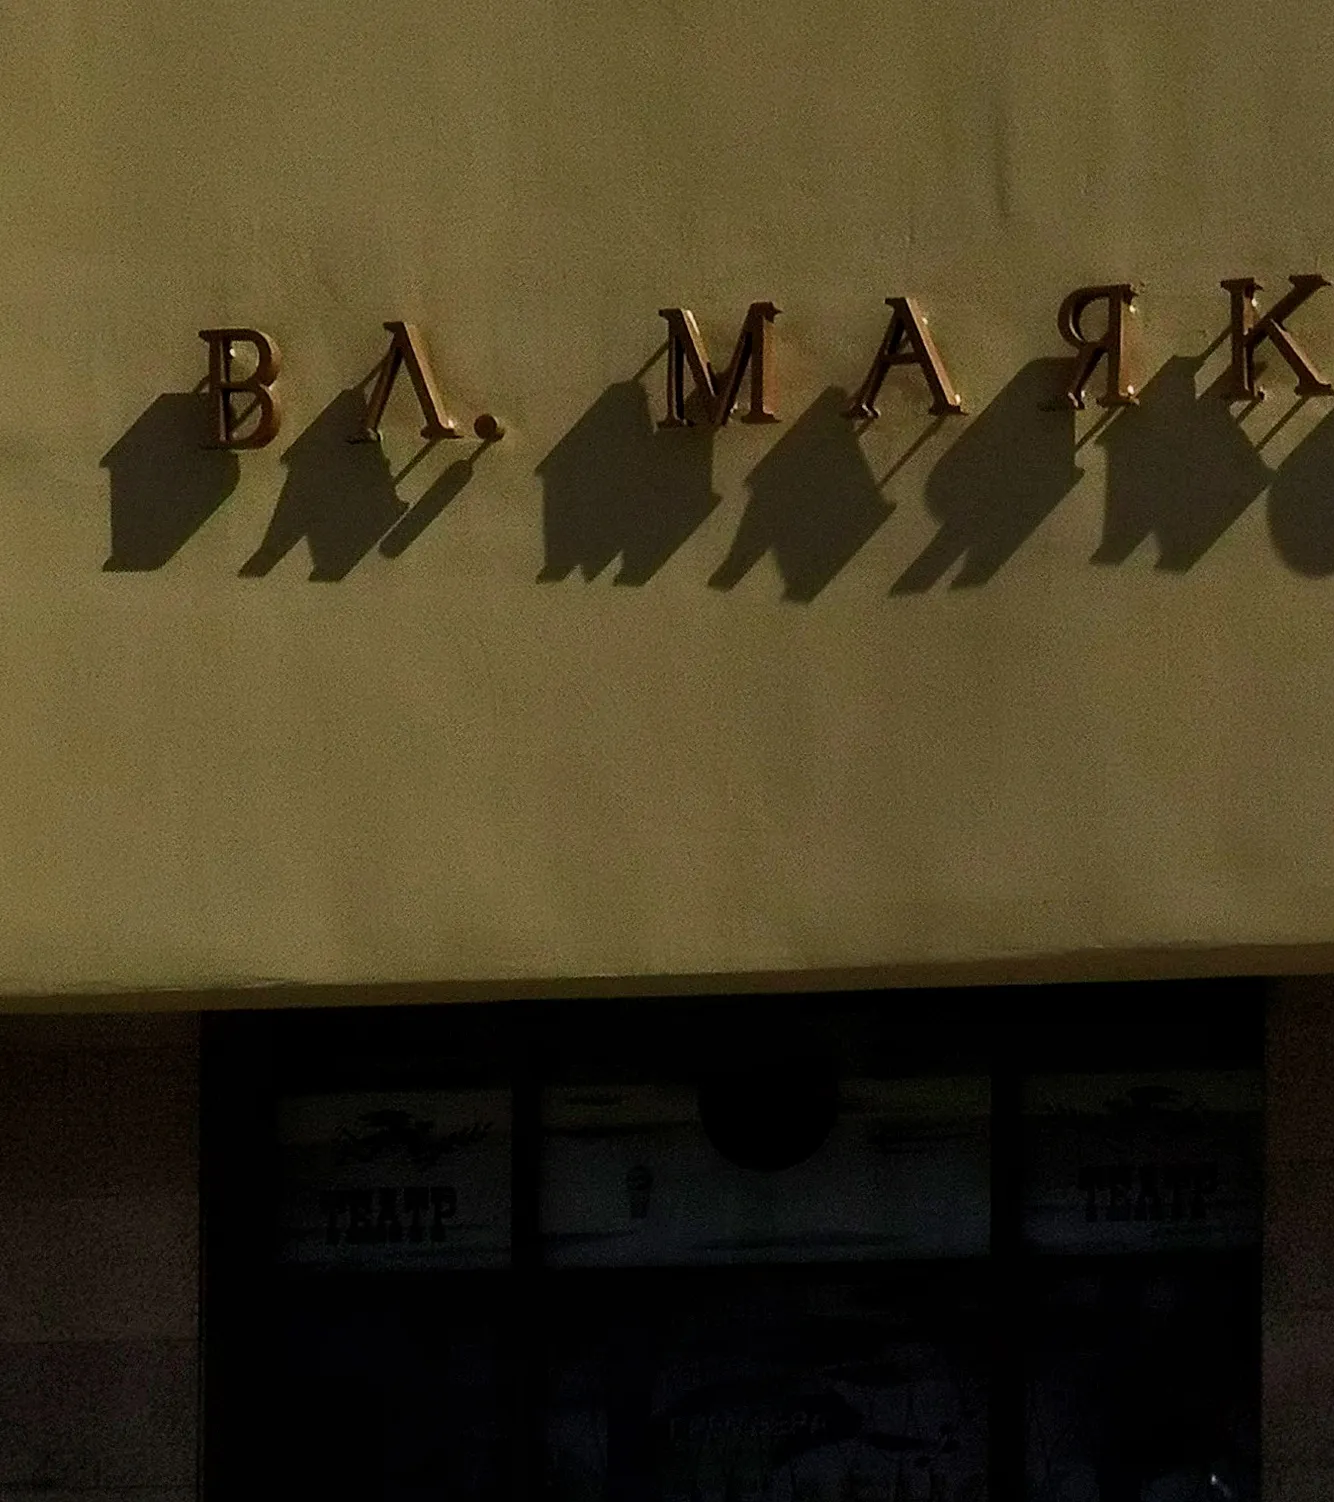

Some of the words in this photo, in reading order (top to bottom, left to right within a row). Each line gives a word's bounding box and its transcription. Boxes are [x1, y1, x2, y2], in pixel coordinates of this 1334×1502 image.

[194, 321, 504, 450] ВЛ.
[318, 1184, 458, 1244] ТЕАТР
[1077, 1163, 1218, 1222] ТЕАТР
